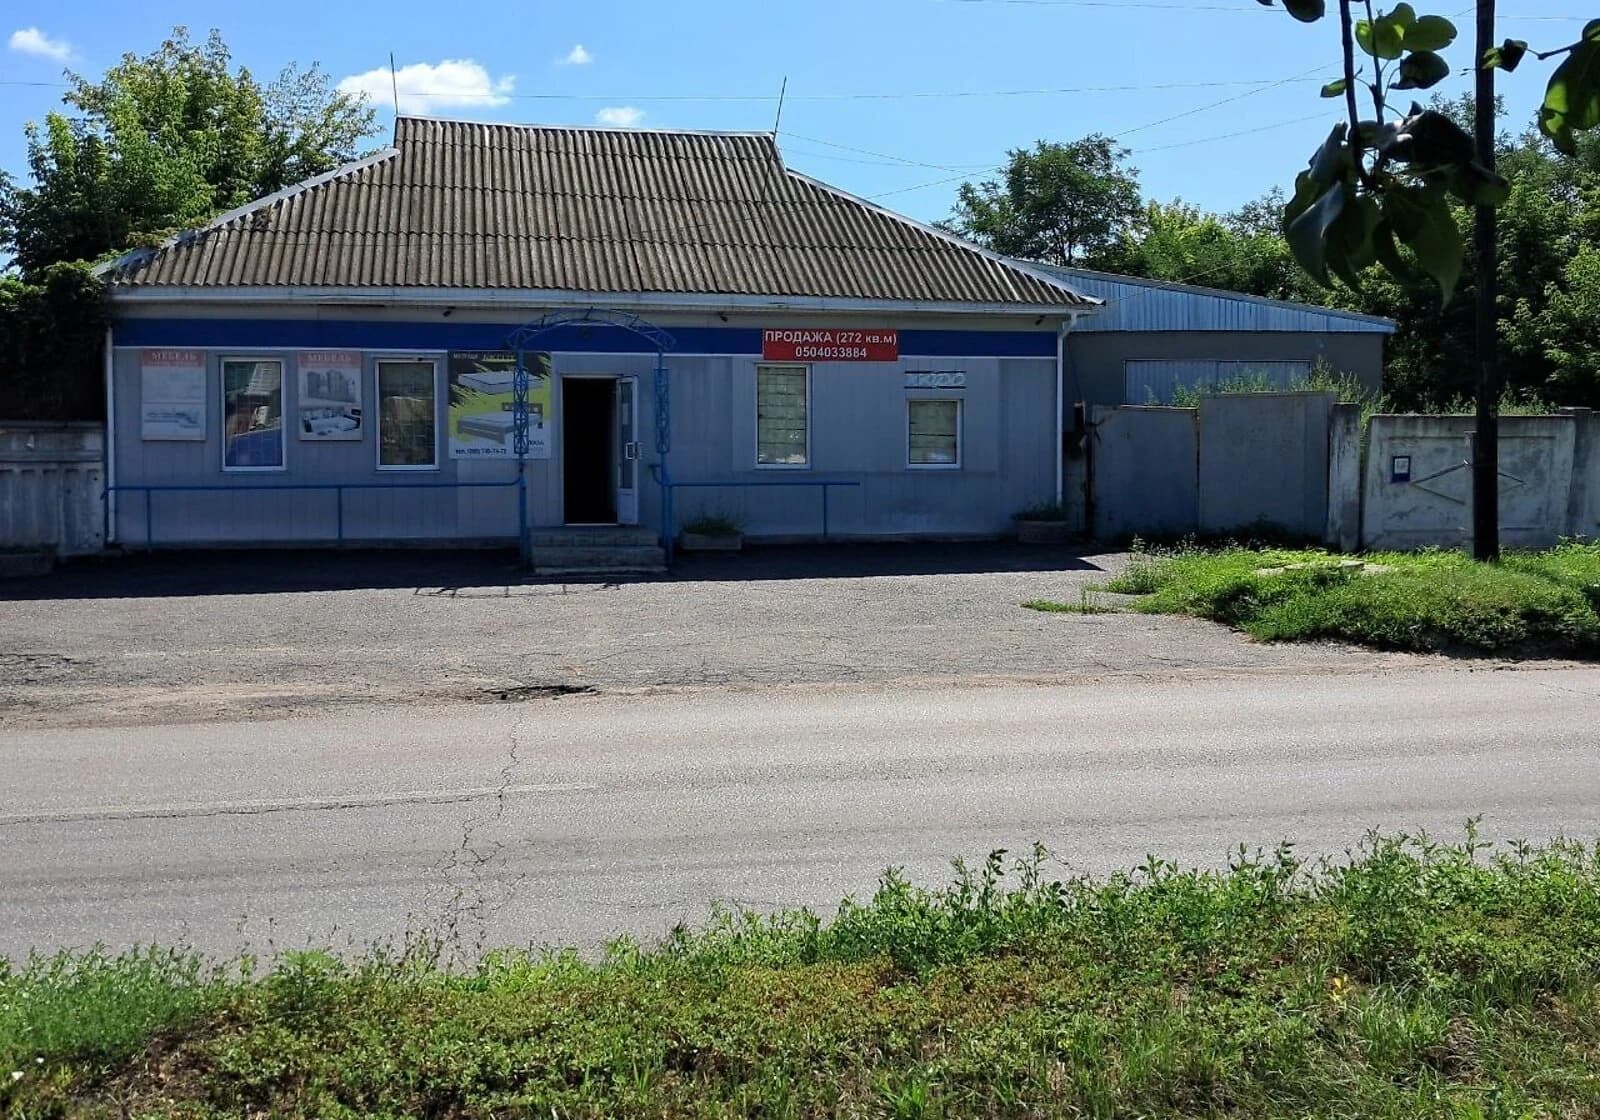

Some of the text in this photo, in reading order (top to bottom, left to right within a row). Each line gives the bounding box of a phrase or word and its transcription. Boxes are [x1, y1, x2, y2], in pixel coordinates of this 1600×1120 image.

[765, 330, 897, 346] ПРОДАЖА (272 кв.м)
[795, 346, 868, 358] 0504033884
